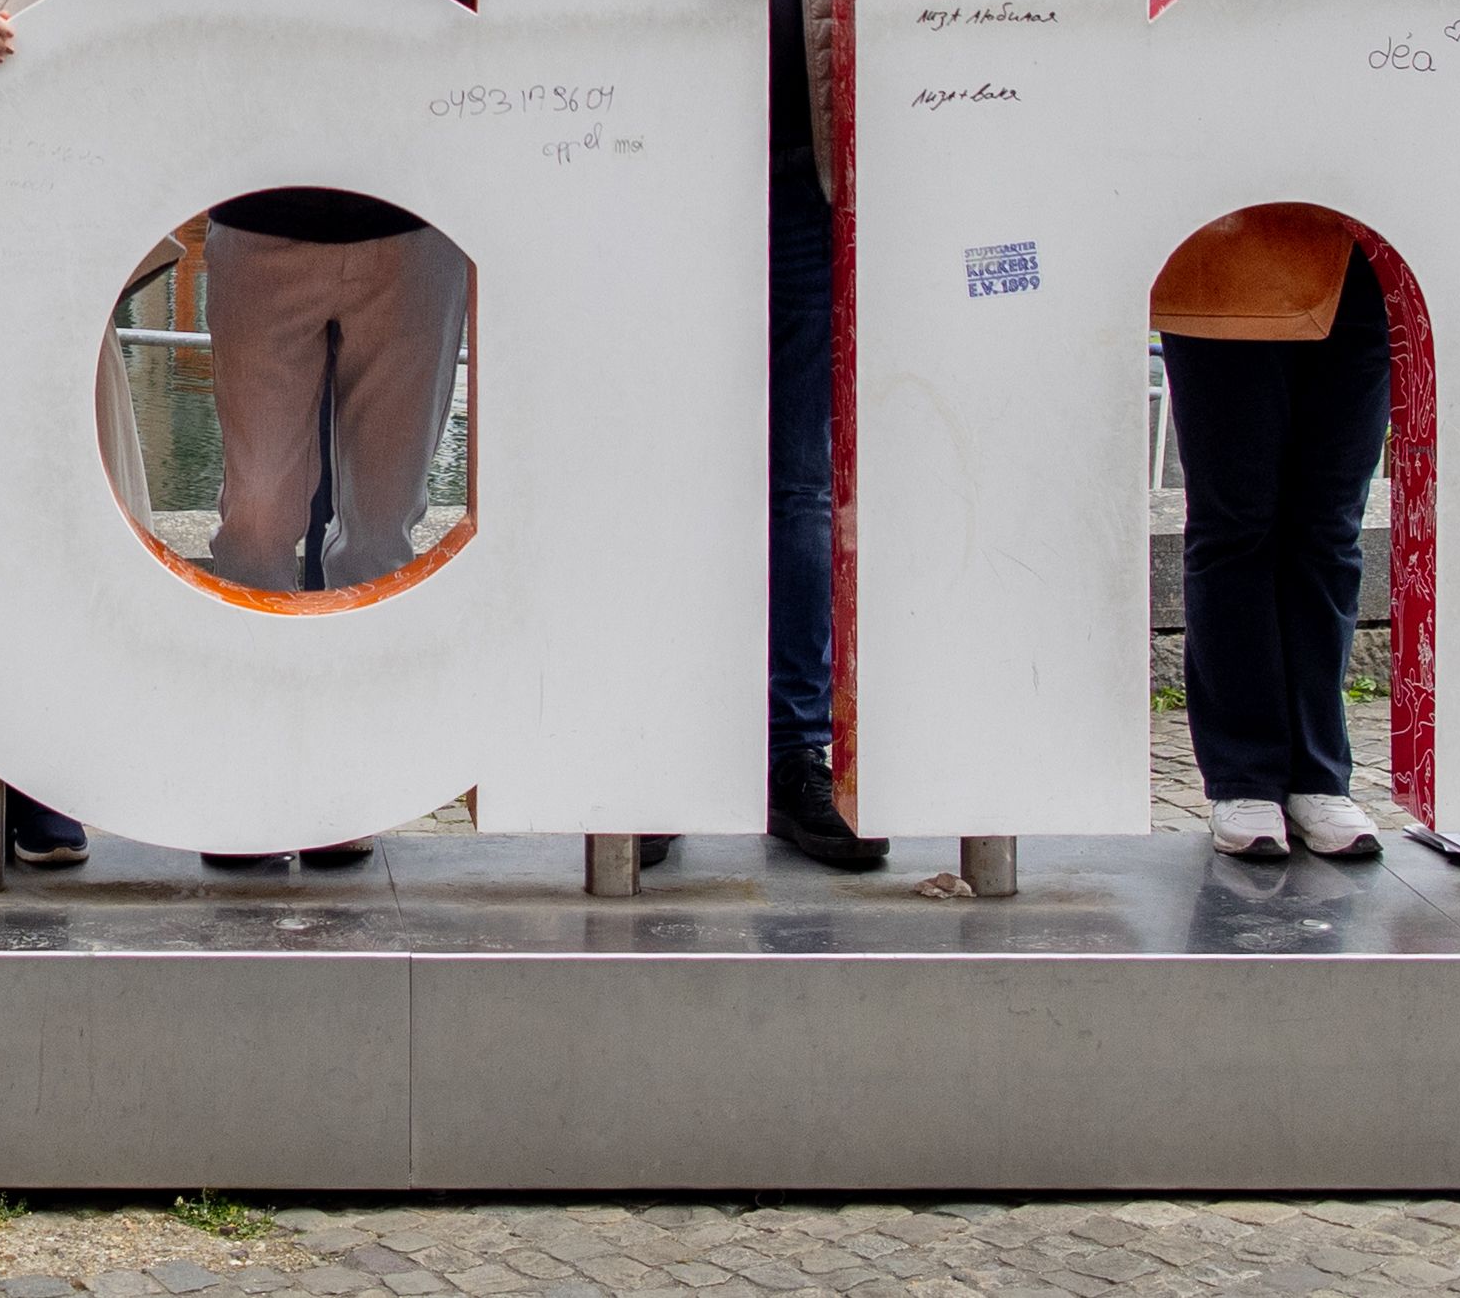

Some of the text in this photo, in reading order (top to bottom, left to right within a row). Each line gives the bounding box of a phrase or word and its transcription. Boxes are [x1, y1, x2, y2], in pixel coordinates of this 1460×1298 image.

[966, 255, 1038, 278] KICKERS
[968, 275, 1040, 298] E.V. 1899
